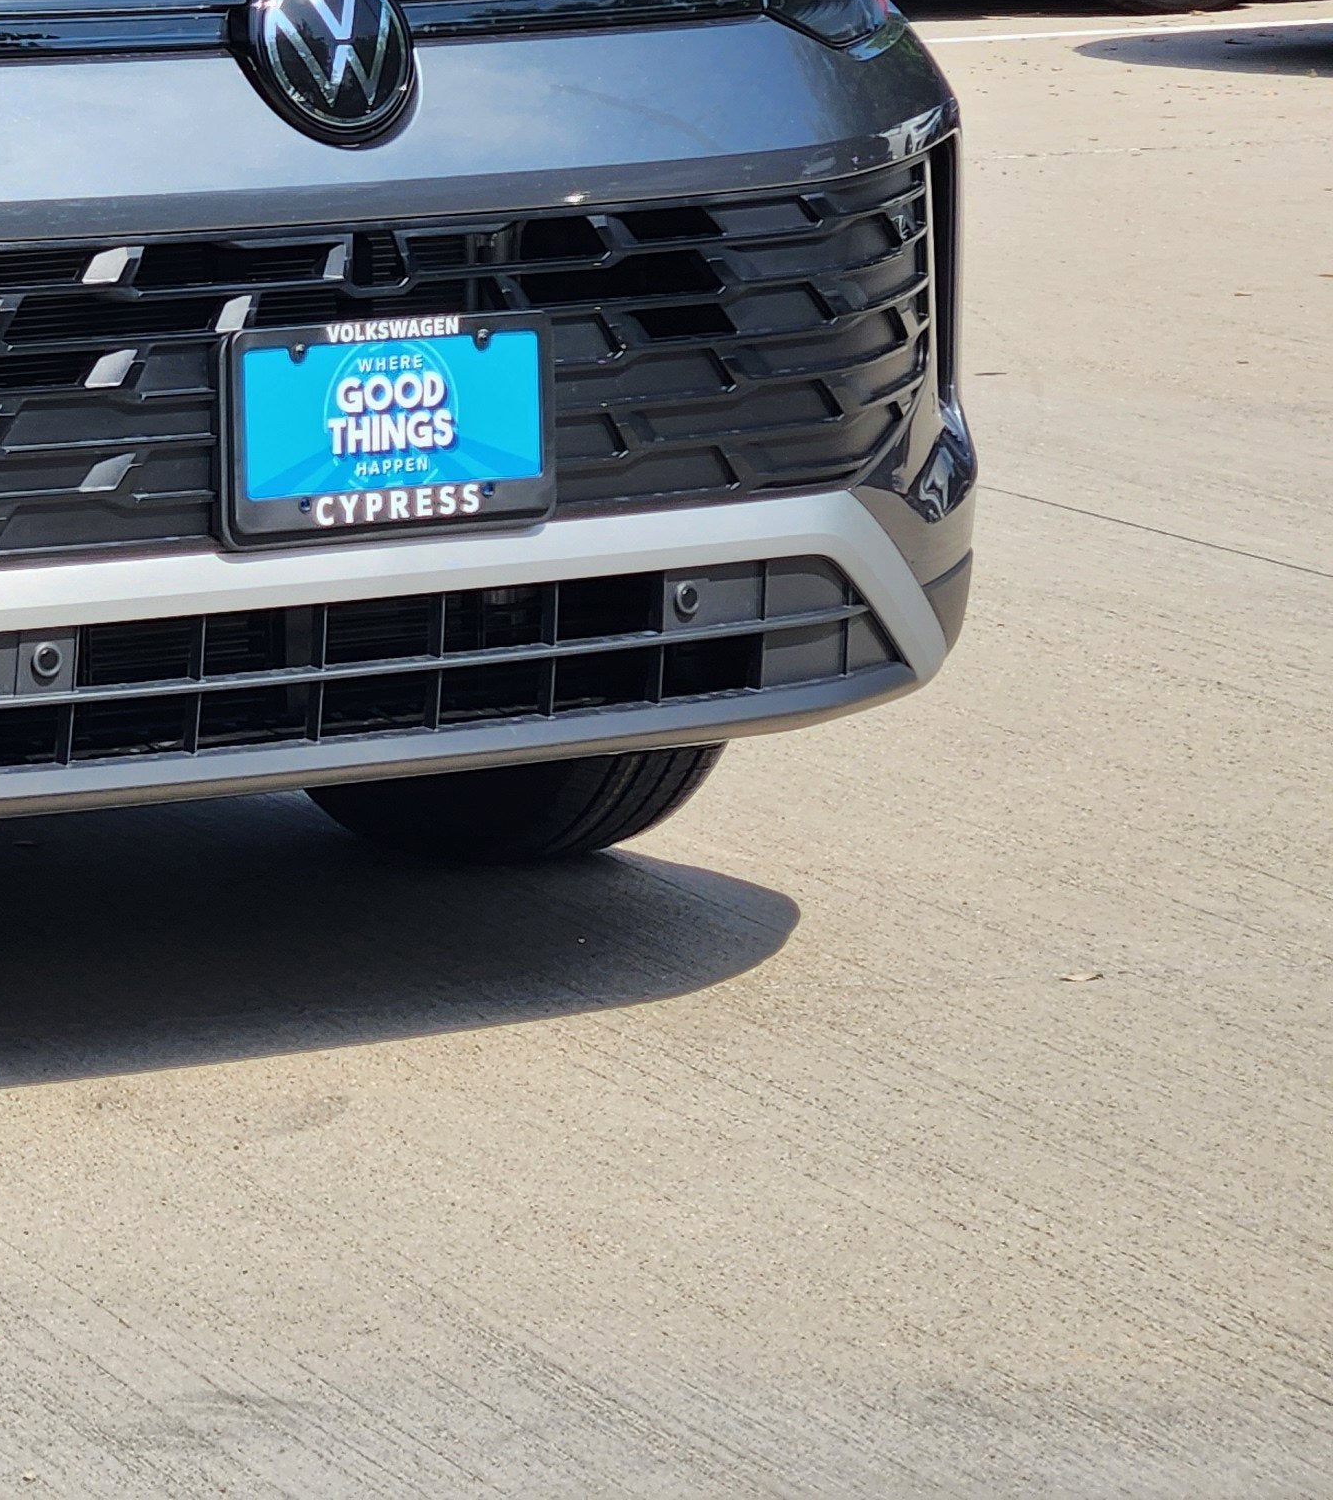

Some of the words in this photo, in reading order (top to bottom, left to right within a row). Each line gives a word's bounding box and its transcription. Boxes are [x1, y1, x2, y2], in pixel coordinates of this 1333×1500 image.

[326, 316, 460, 344] VOLKSWAGEN
[357, 353, 424, 372] WHERE
[336, 371, 446, 413] GOOD
[327, 409, 455, 455] THINGS
[355, 457, 429, 477] HAPPEN
[315, 484, 480, 527] CYPRESS
